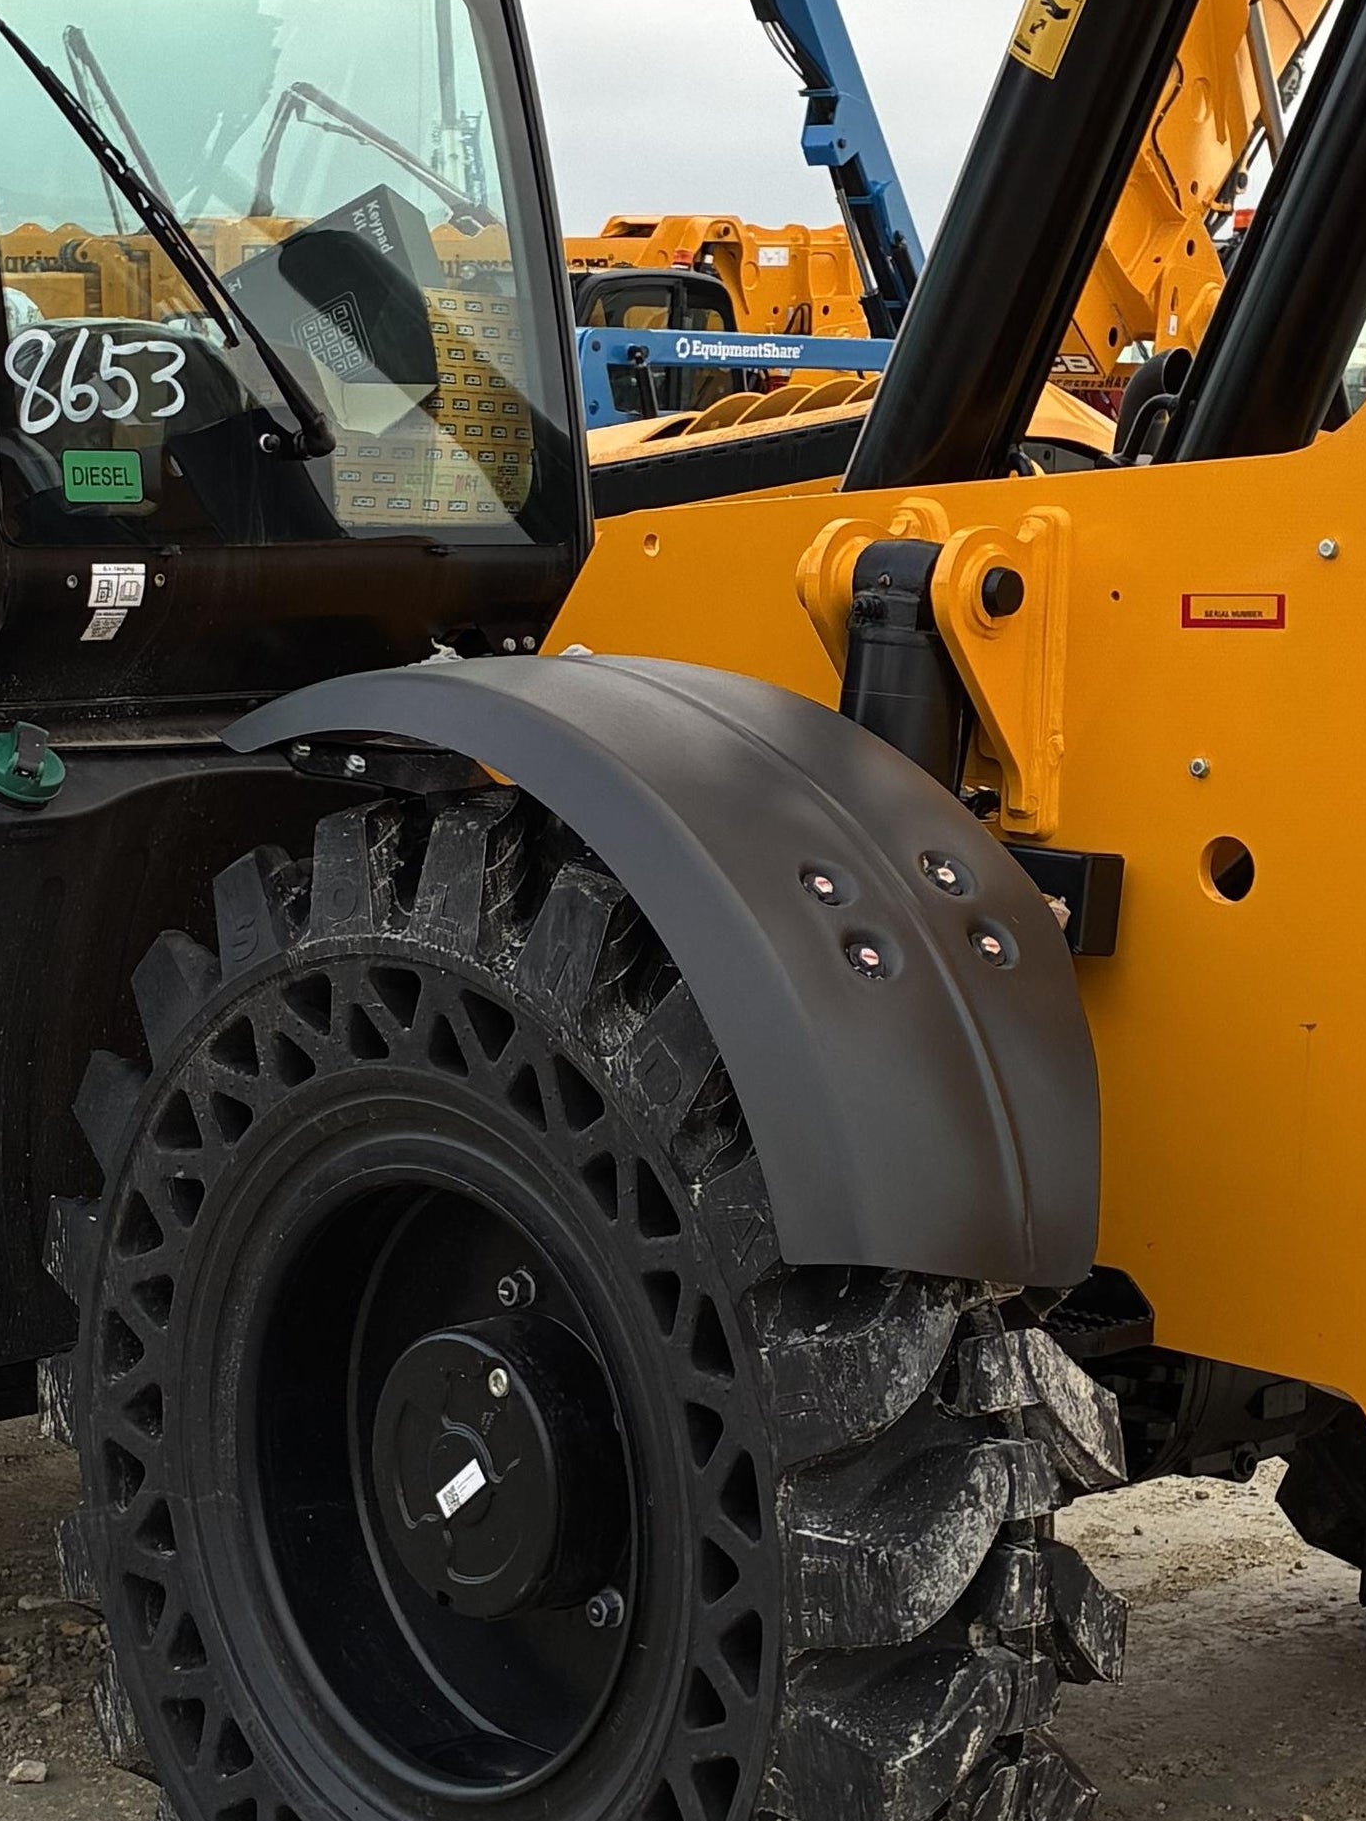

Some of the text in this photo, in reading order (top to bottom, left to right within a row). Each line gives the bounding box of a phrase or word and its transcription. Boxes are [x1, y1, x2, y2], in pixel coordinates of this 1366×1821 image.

[351, 207, 367, 233] Kit
[365, 198, 395, 255] Keypad
[4, 327, 186, 435] 8653
[72, 466, 134, 486] DIESEL
